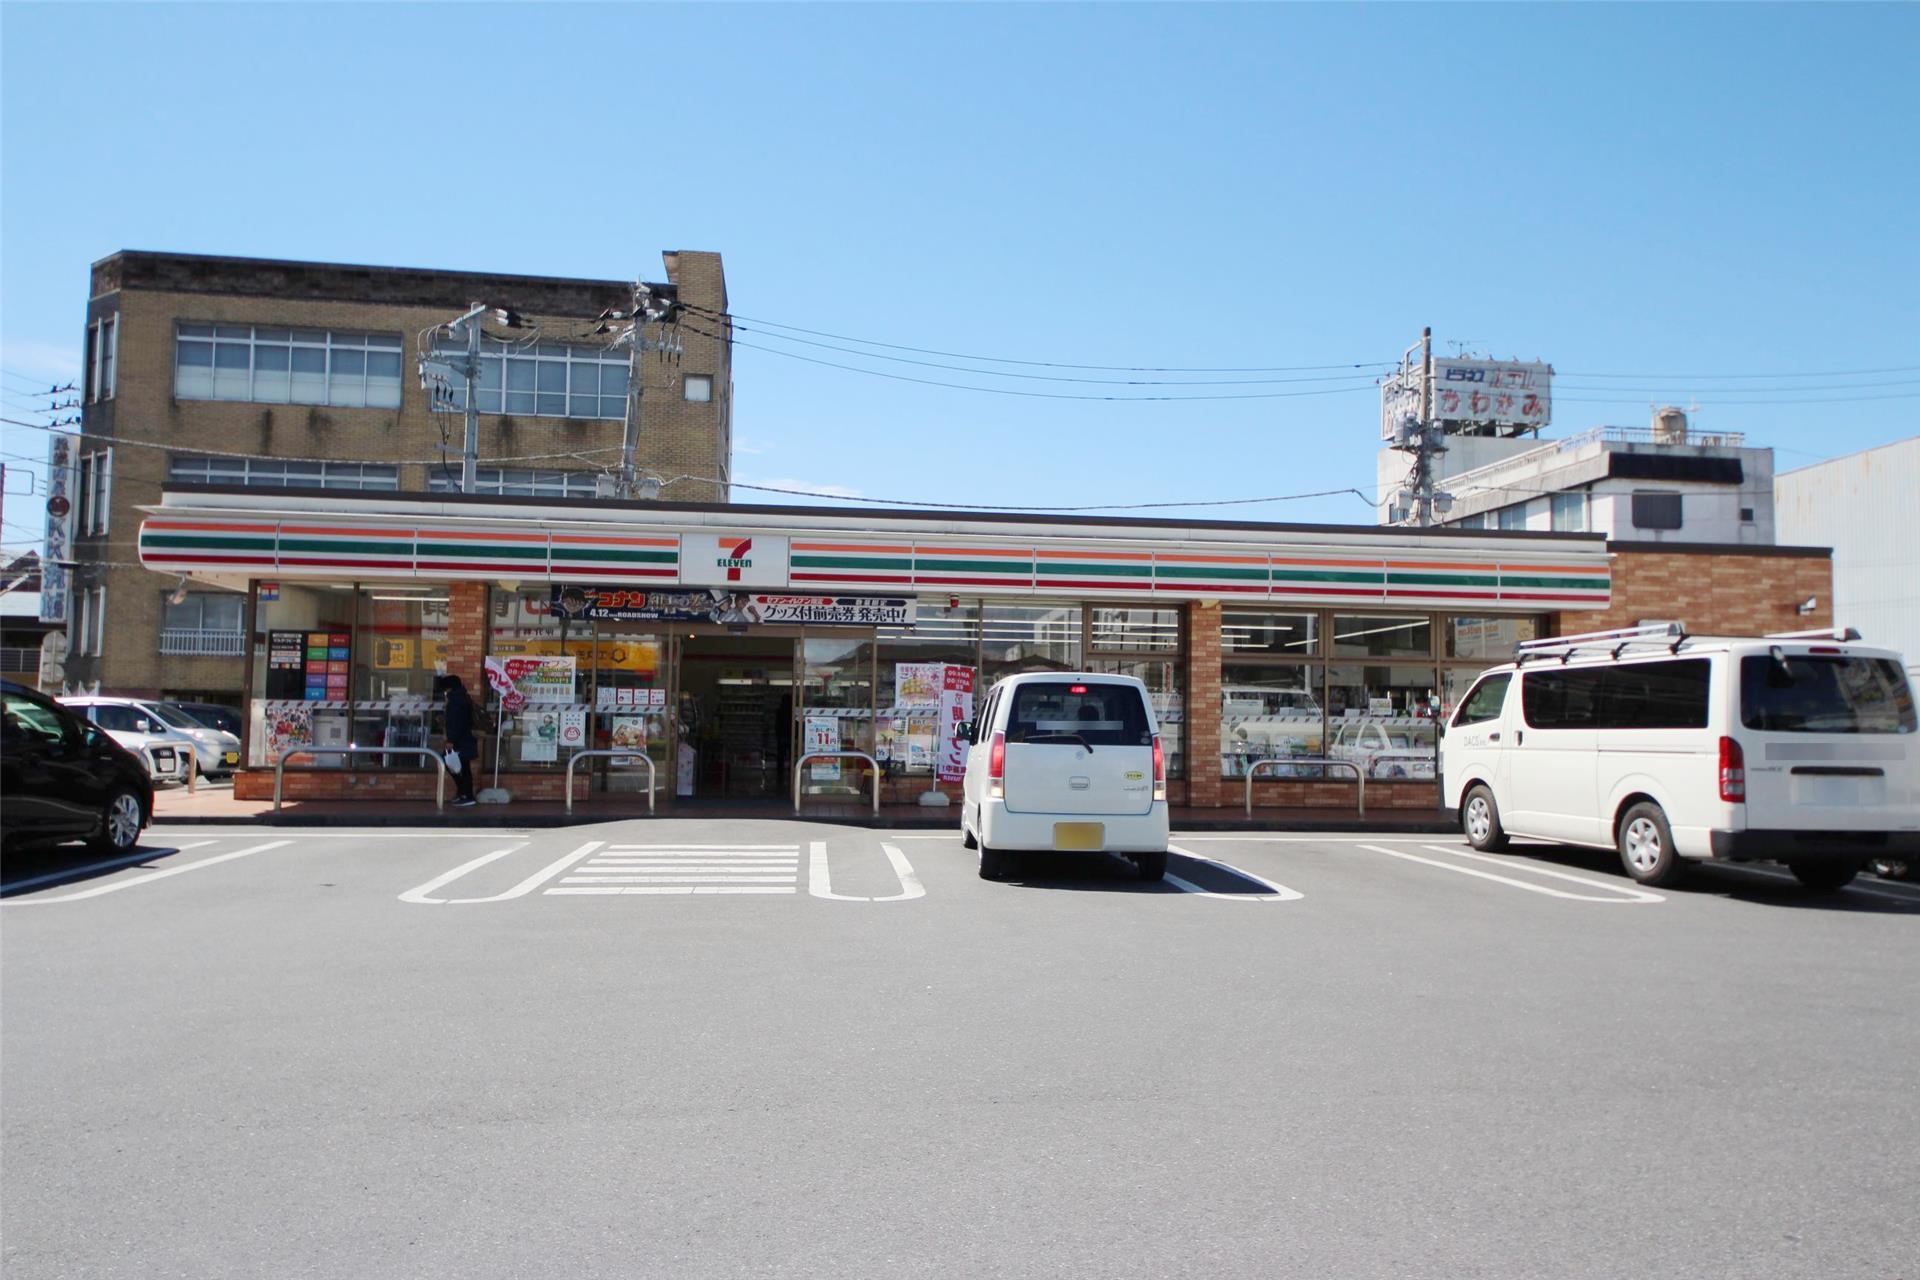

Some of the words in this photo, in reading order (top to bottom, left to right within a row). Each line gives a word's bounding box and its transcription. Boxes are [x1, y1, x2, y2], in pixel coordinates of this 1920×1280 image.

[597, 590, 646, 608] コナン
[589, 608, 609, 618] 4.12
[764, 605, 857, 621] グッズ付前売券
